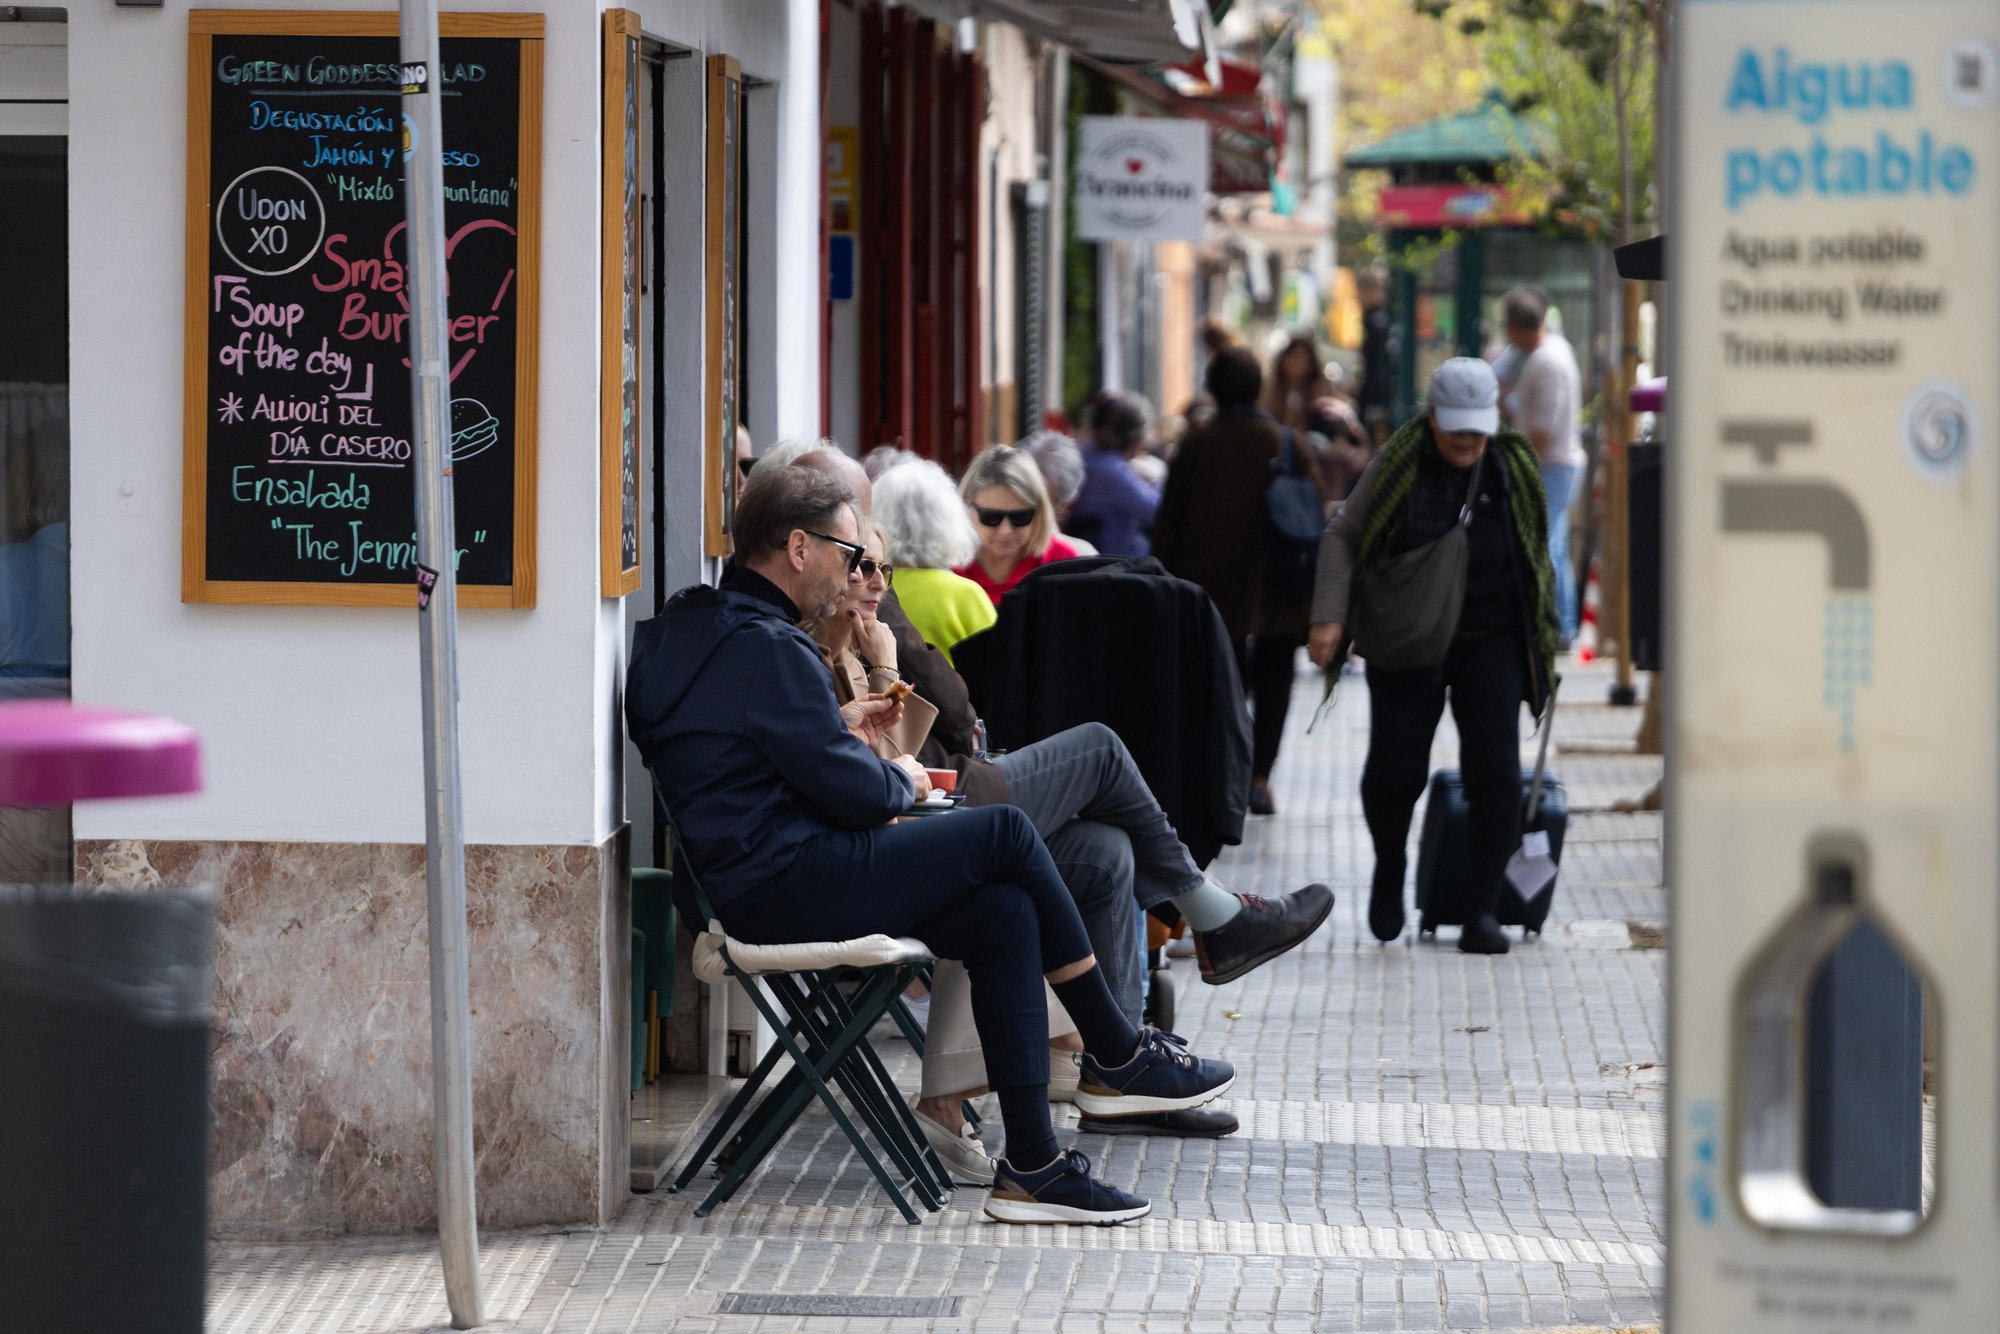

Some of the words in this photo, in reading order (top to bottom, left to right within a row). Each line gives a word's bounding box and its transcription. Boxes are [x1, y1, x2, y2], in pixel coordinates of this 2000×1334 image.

[218, 55, 301, 84] GREEN
[1724, 45, 1914, 127] Aigua
[303, 134, 374, 168] JAMÓN
[1723, 128, 1977, 212] potable
[238, 187, 306, 221] UDON
[248, 224, 288, 256] XO
[1721, 228, 1801, 271] Agua
[1807, 226, 1927, 269] potable
[312, 233, 450, 298] Sma
[230, 285, 305, 338] Soup
[338, 292, 500, 344] Burer
[1720, 278, 1845, 326] Drinking
[1855, 281, 1946, 320] Water
[219, 331, 252, 376] of
[254, 334, 300, 371] the
[305, 336, 352, 391] day
[1721, 331, 1902, 370] Trinkwasser
[339, 404, 381, 426] DEL
[270, 426, 310, 457] DÍA
[320, 433, 411, 460] CASERO
[232, 465, 371, 510] Ensalada
